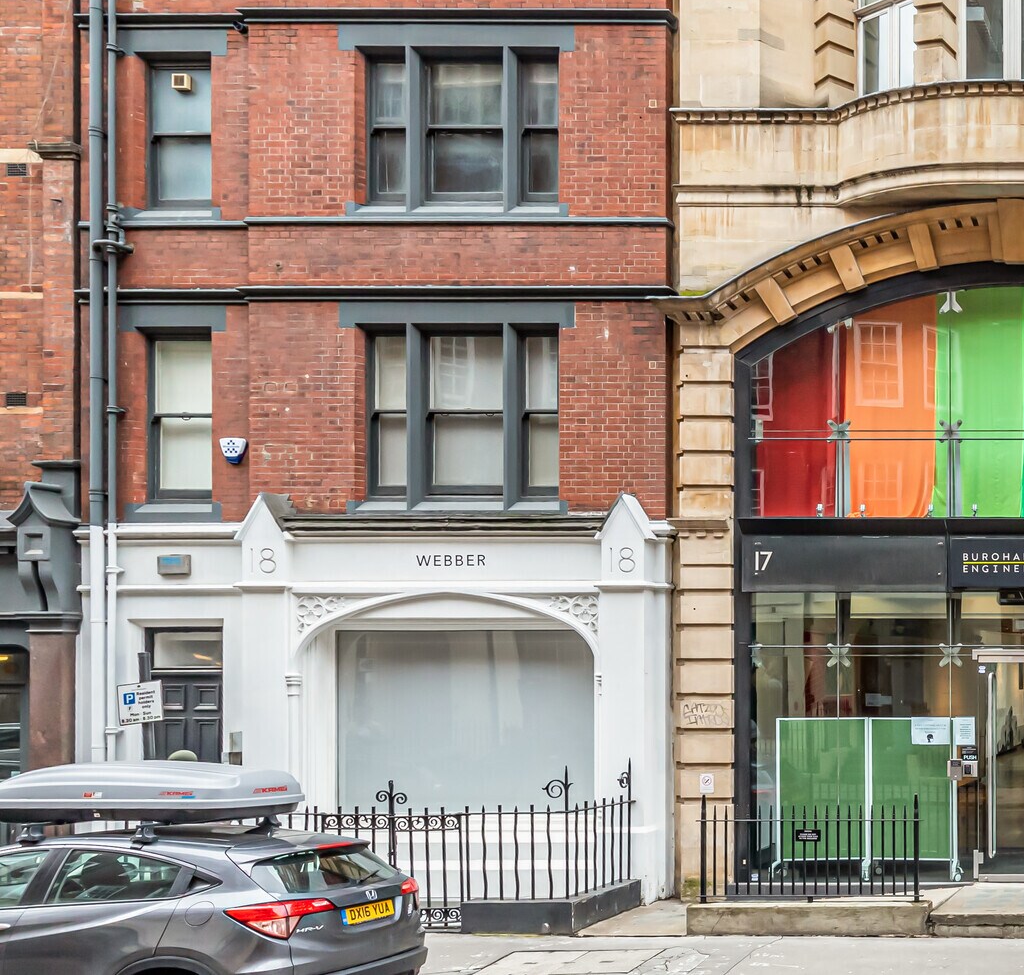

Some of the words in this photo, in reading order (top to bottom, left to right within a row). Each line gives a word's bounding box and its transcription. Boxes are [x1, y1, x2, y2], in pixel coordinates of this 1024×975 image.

[250, 547, 277, 574] 18
[415, 554, 486, 567] WEBBER
[609, 547, 636, 573] 18
[754, 551, 773, 571] 17
[349, 906, 371, 921] DX16
[373, 902, 391, 916] YUA
